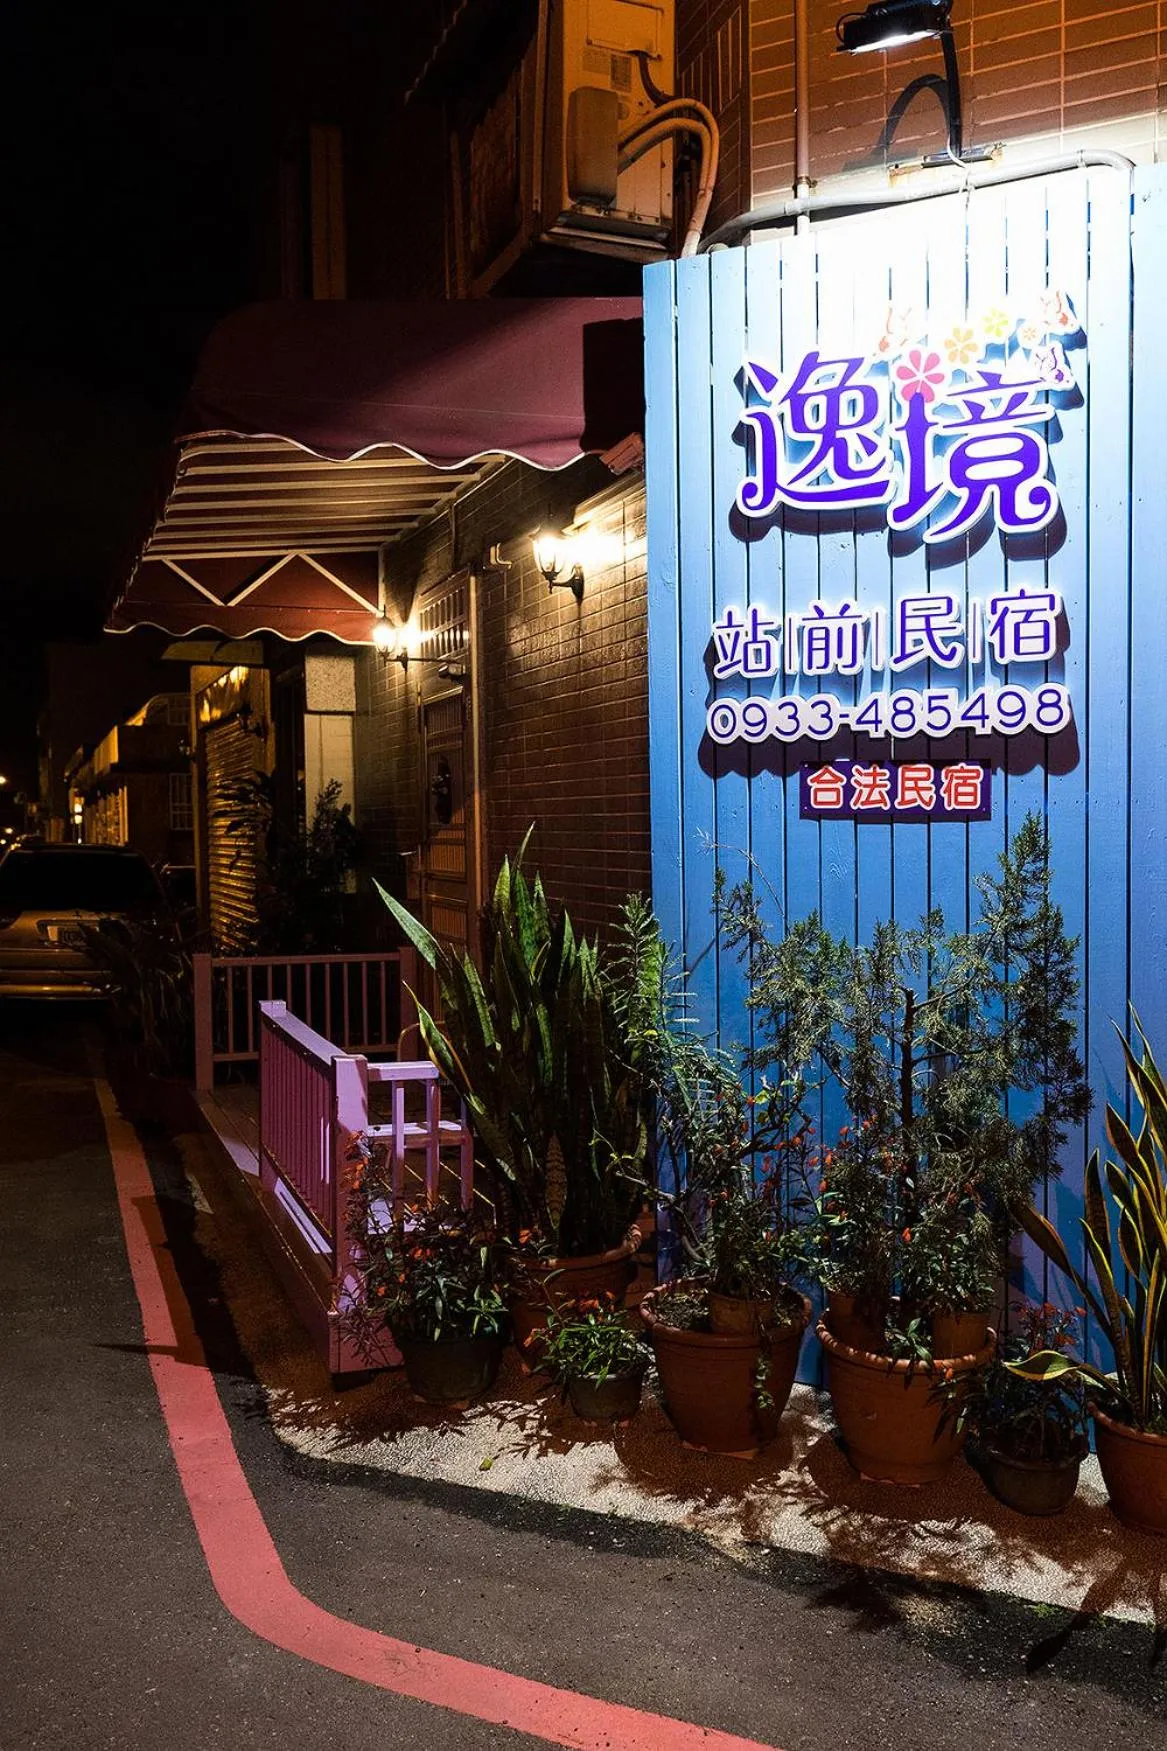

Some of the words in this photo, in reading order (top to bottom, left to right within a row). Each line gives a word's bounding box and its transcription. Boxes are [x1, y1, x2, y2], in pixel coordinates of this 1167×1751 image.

[741, 350, 1052, 537] 逸境
[710, 688, 1065, 739] 0933-485498
[807, 763, 983, 810] 合法民宿
